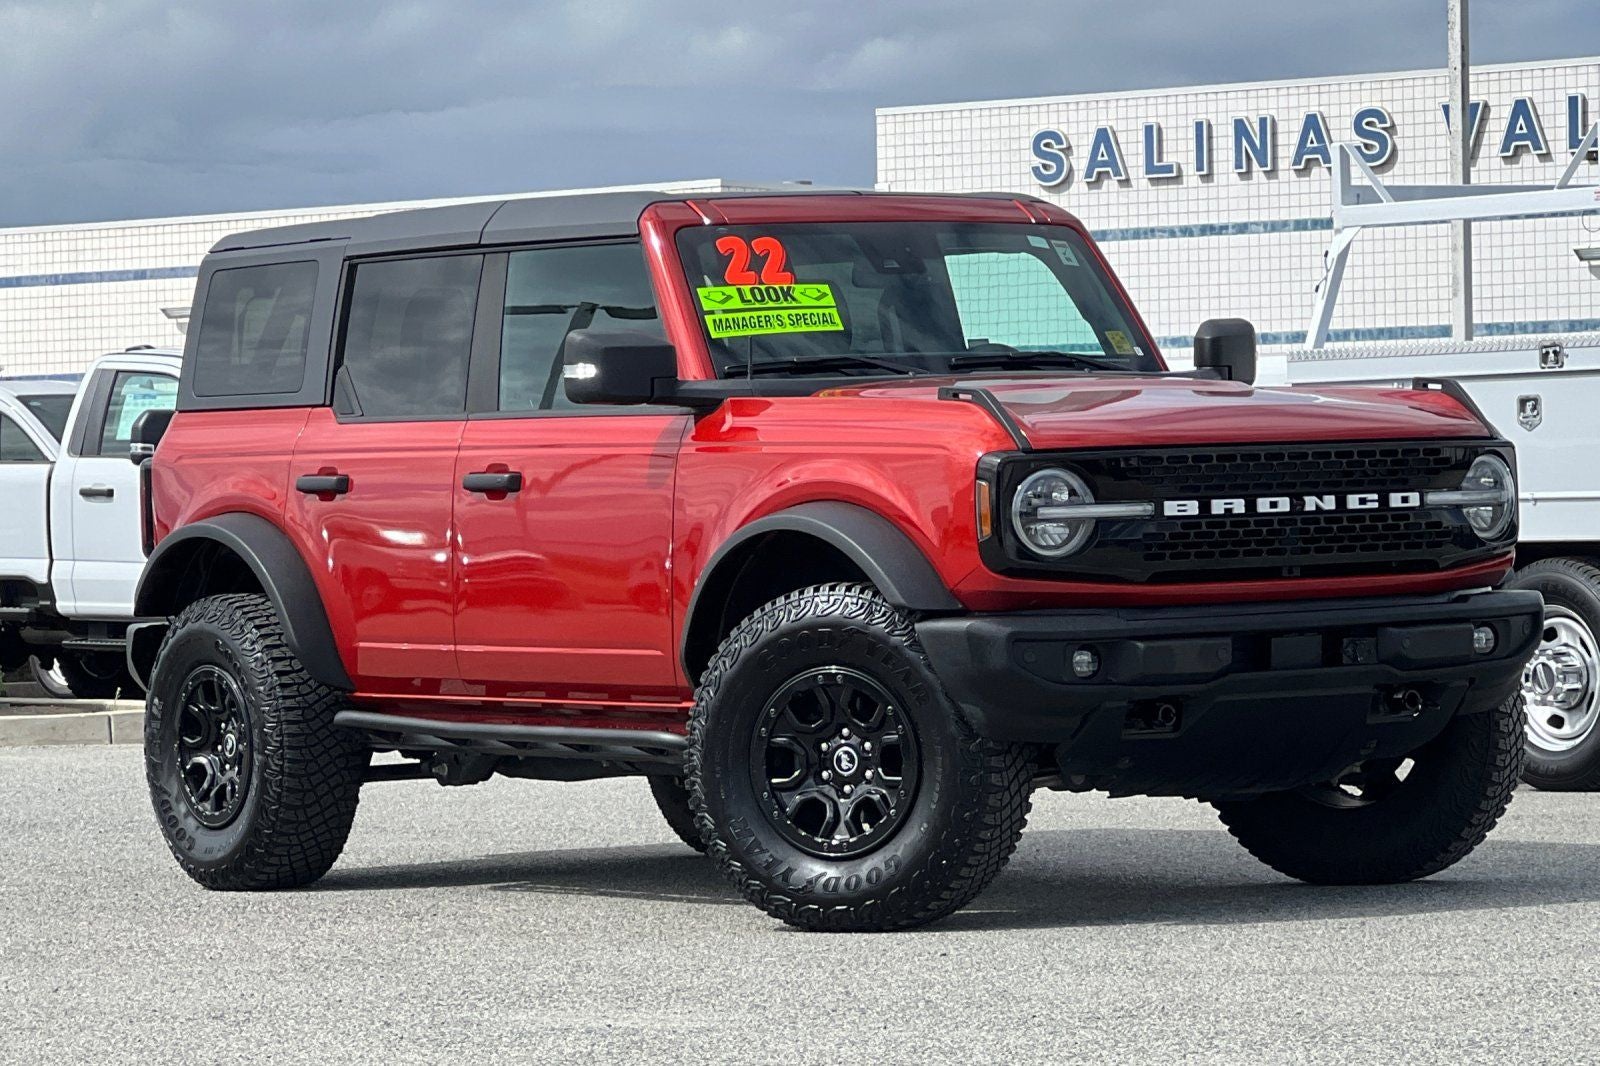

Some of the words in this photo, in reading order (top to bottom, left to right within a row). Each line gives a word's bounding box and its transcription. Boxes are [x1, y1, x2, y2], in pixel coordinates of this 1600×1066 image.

[1030, 106, 1393, 187] SALINAS
[715, 236, 795, 285] 22
[736, 285, 801, 305] LOOK
[712, 313, 786, 334] MANAGER'S
[788, 311, 838, 329] SPECIAL
[1164, 492, 1420, 516] BRONCO
[727, 814, 904, 895] GOODYEAR
